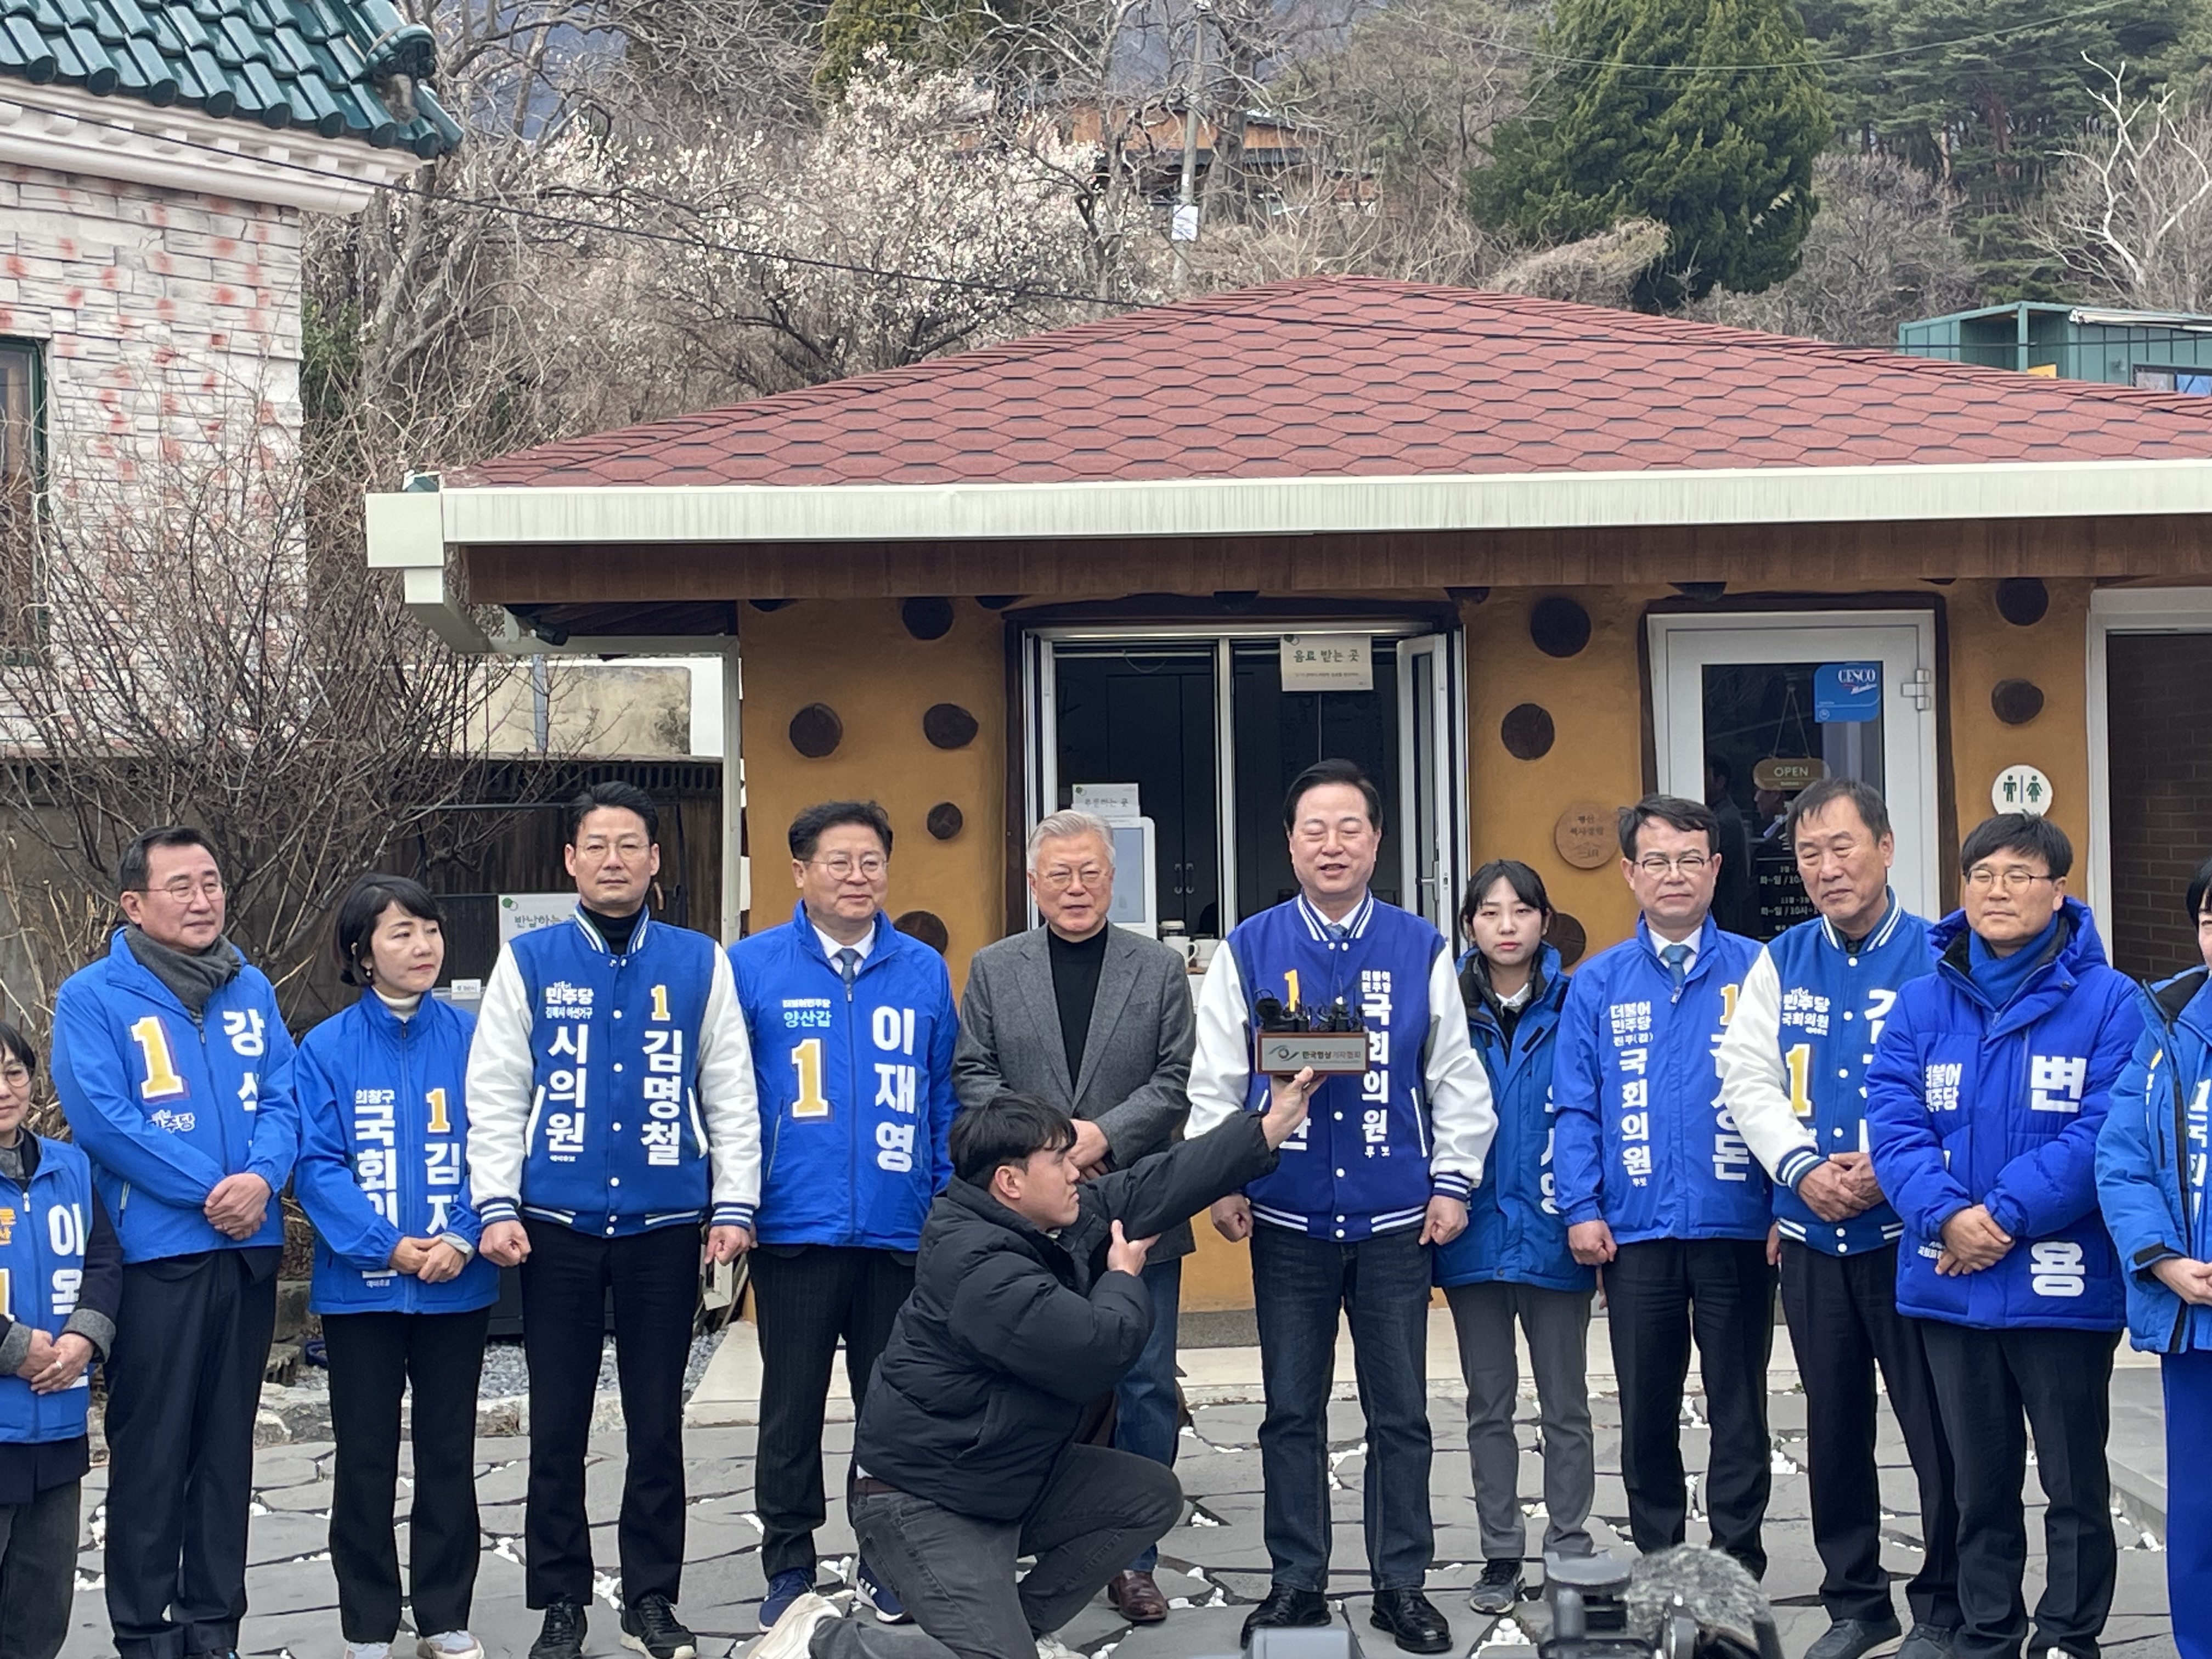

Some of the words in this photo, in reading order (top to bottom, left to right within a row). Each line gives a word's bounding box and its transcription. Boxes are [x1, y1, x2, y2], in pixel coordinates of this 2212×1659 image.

[1293, 650, 1317, 663] 음료
[1321, 649, 1343, 663] 받는
[1347, 649, 1359, 662] 곳
[1838, 669, 1876, 683] CESCO
[1774, 766, 1809, 777] OPEN
[546, 987, 594, 1005] 민주당
[651, 985, 670, 1021] 1
[1610, 1001, 1651, 1019] 더불어
[1783, 994, 1830, 1013] 민주당
[783, 1010, 833, 1029] 양산갑
[1611, 1015, 1652, 1035] 민주당
[1782, 1012, 1829, 1029] 국회의원
[131, 1016, 184, 1099] 1
[1361, 994, 1392, 1143] 국회의원
[355, 1089, 396, 1104] 의창구
[546, 1024, 588, 1152] 시의원
[791, 1039, 828, 1118] 1
[872, 1006, 915, 1172] 이재영
[1785, 1043, 1812, 1116] 1
[426, 1088, 451, 1133] 1
[640, 1030, 683, 1166] 김명철
[1620, 1048, 1652, 1176] 국회의원
[2030, 1055, 2087, 1297] 변용
